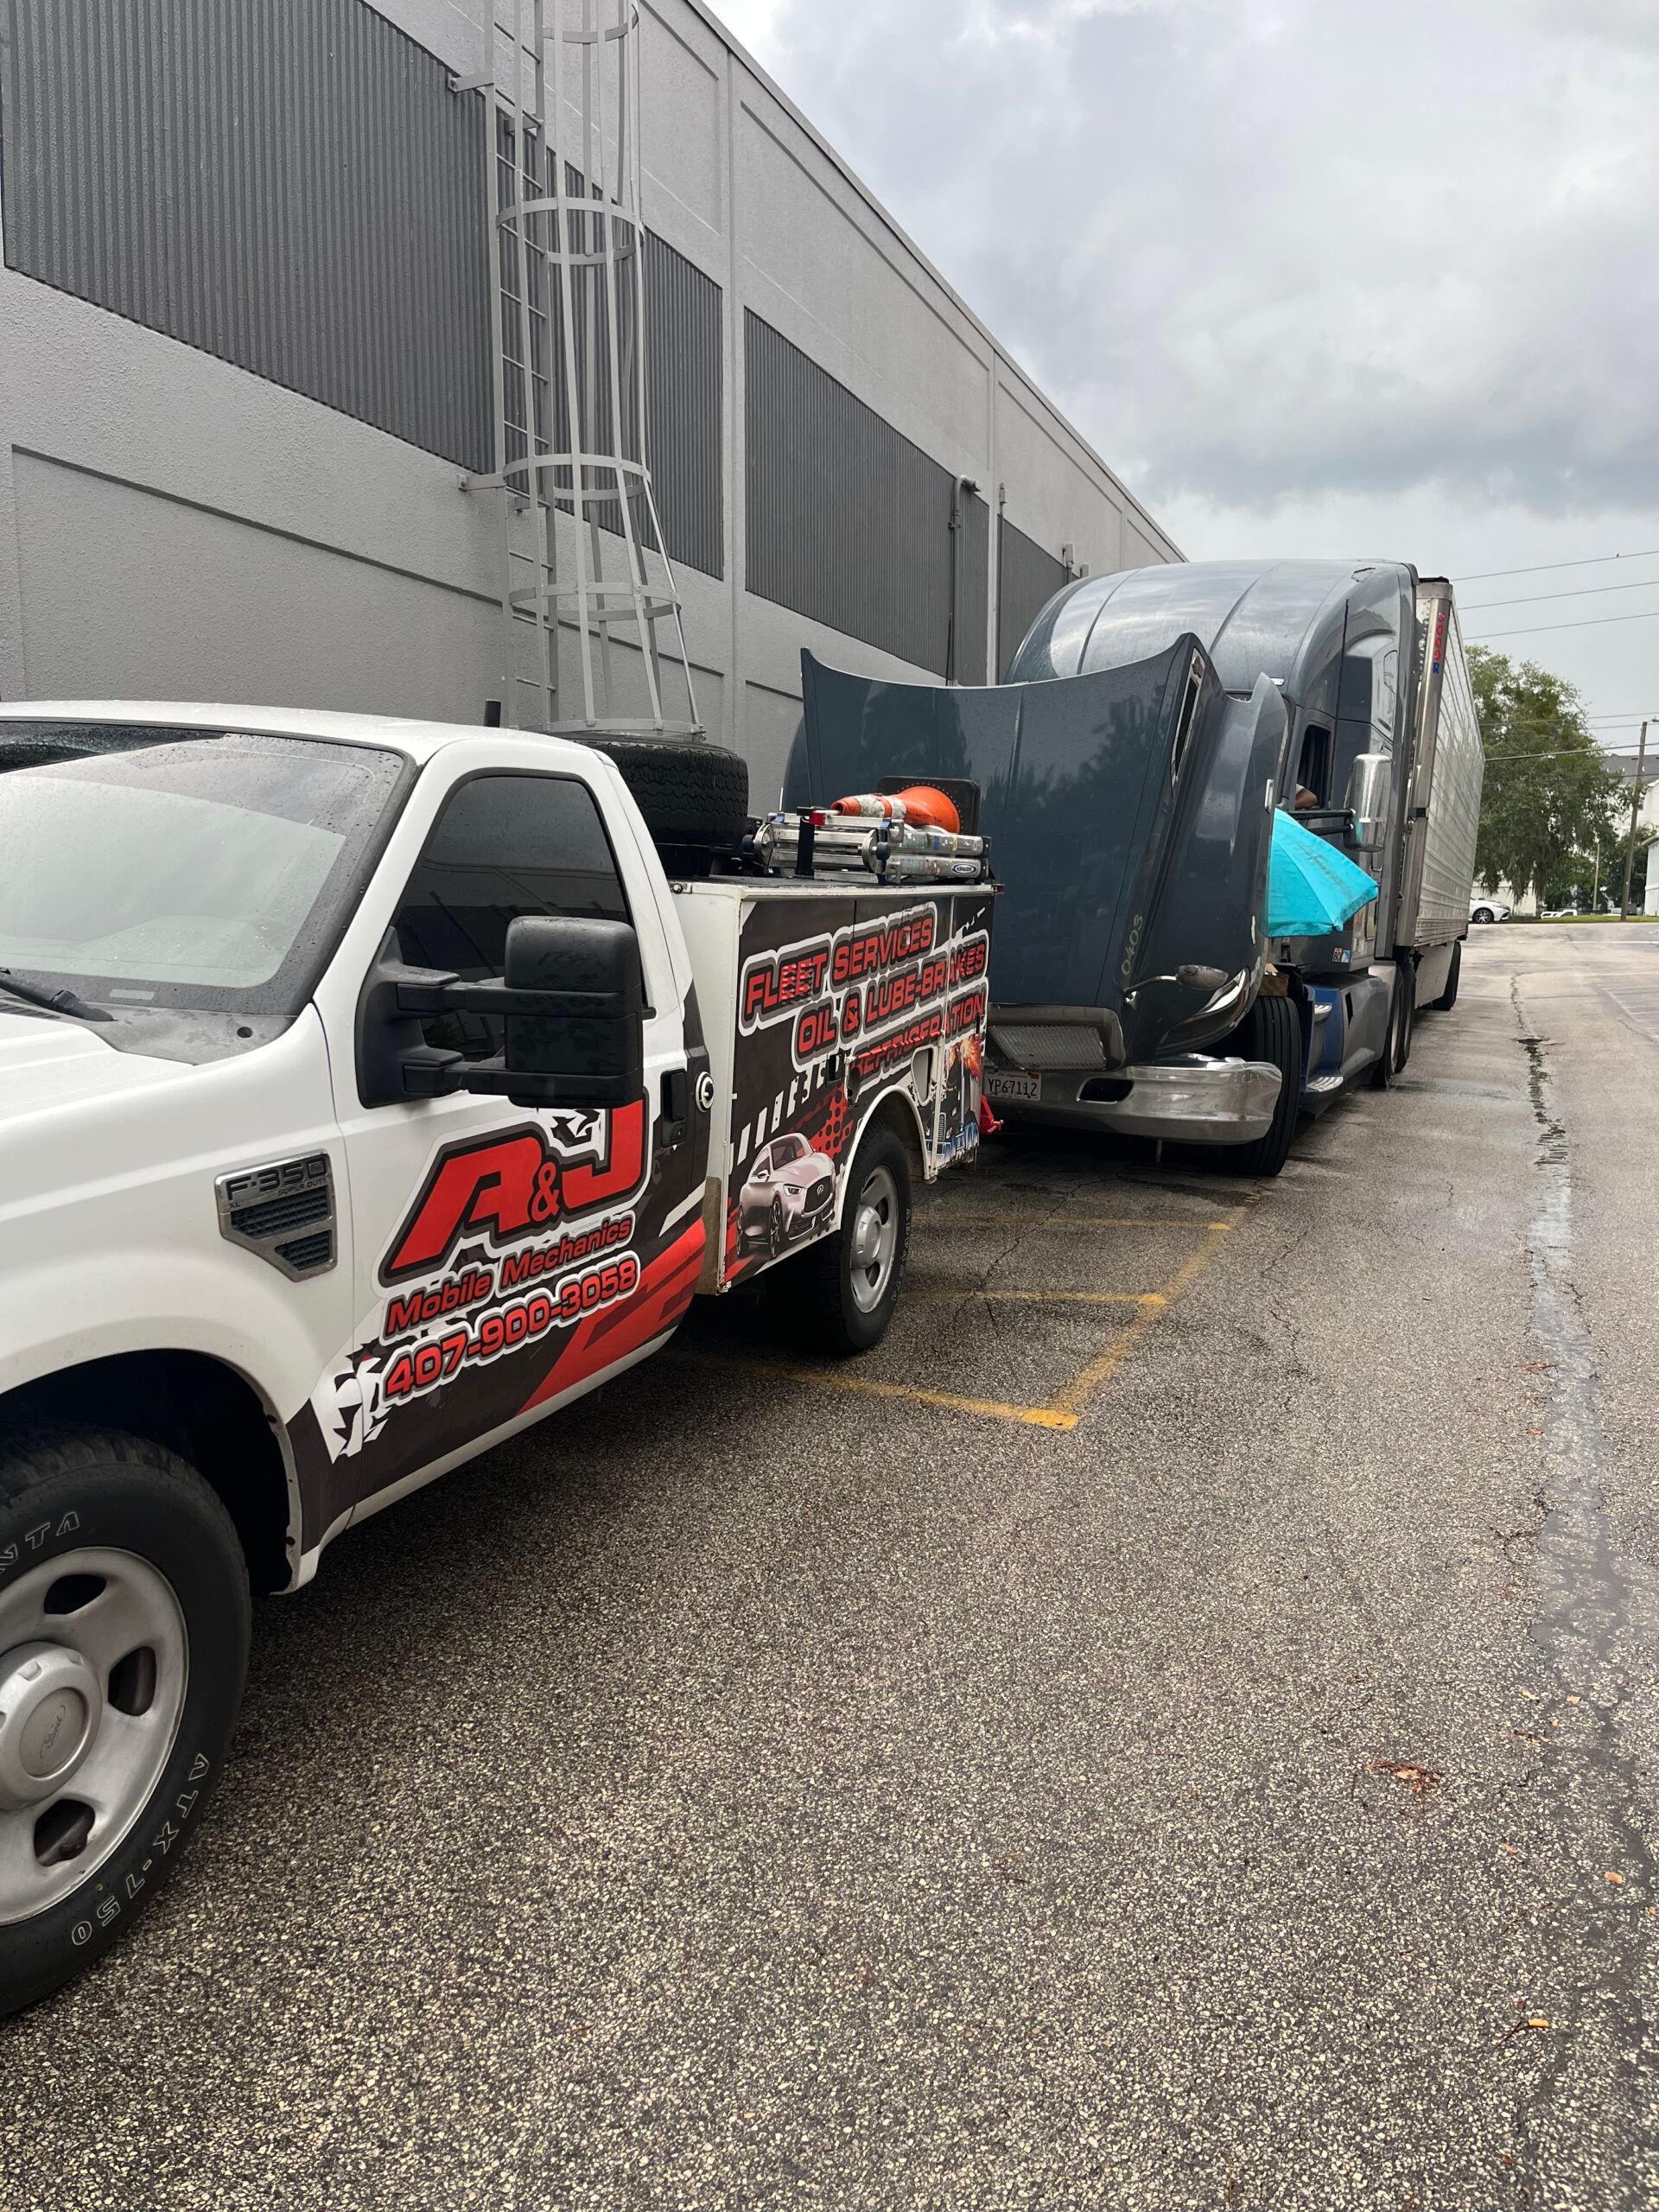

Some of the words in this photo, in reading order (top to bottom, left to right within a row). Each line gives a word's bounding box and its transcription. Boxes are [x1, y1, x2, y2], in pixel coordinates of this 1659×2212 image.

[745, 951, 828, 1015] FLEET
[833, 916, 934, 982] SERVICES
[1121, 914, 1143, 976] 0403
[798, 1008, 836, 1053] OIL
[843, 997, 859, 1033] &
[866, 943, 985, 1023] LUBE-BRAKES
[987, 1077, 1038, 1097] YP67112
[226, 1155, 327, 1201] F-350
[228, 1201, 241, 1210] XL
[277, 1182, 306, 1197] SUPER
[307, 1178, 327, 1189] DUTY
[390, 1098, 645, 1271] A&J
[386, 1268, 493, 1334] Mobile
[500, 1216, 633, 1287] Mechanics
[385, 1258, 639, 1396] 407-900-3058
[71, 1752, 210, 1946] ATX-750
